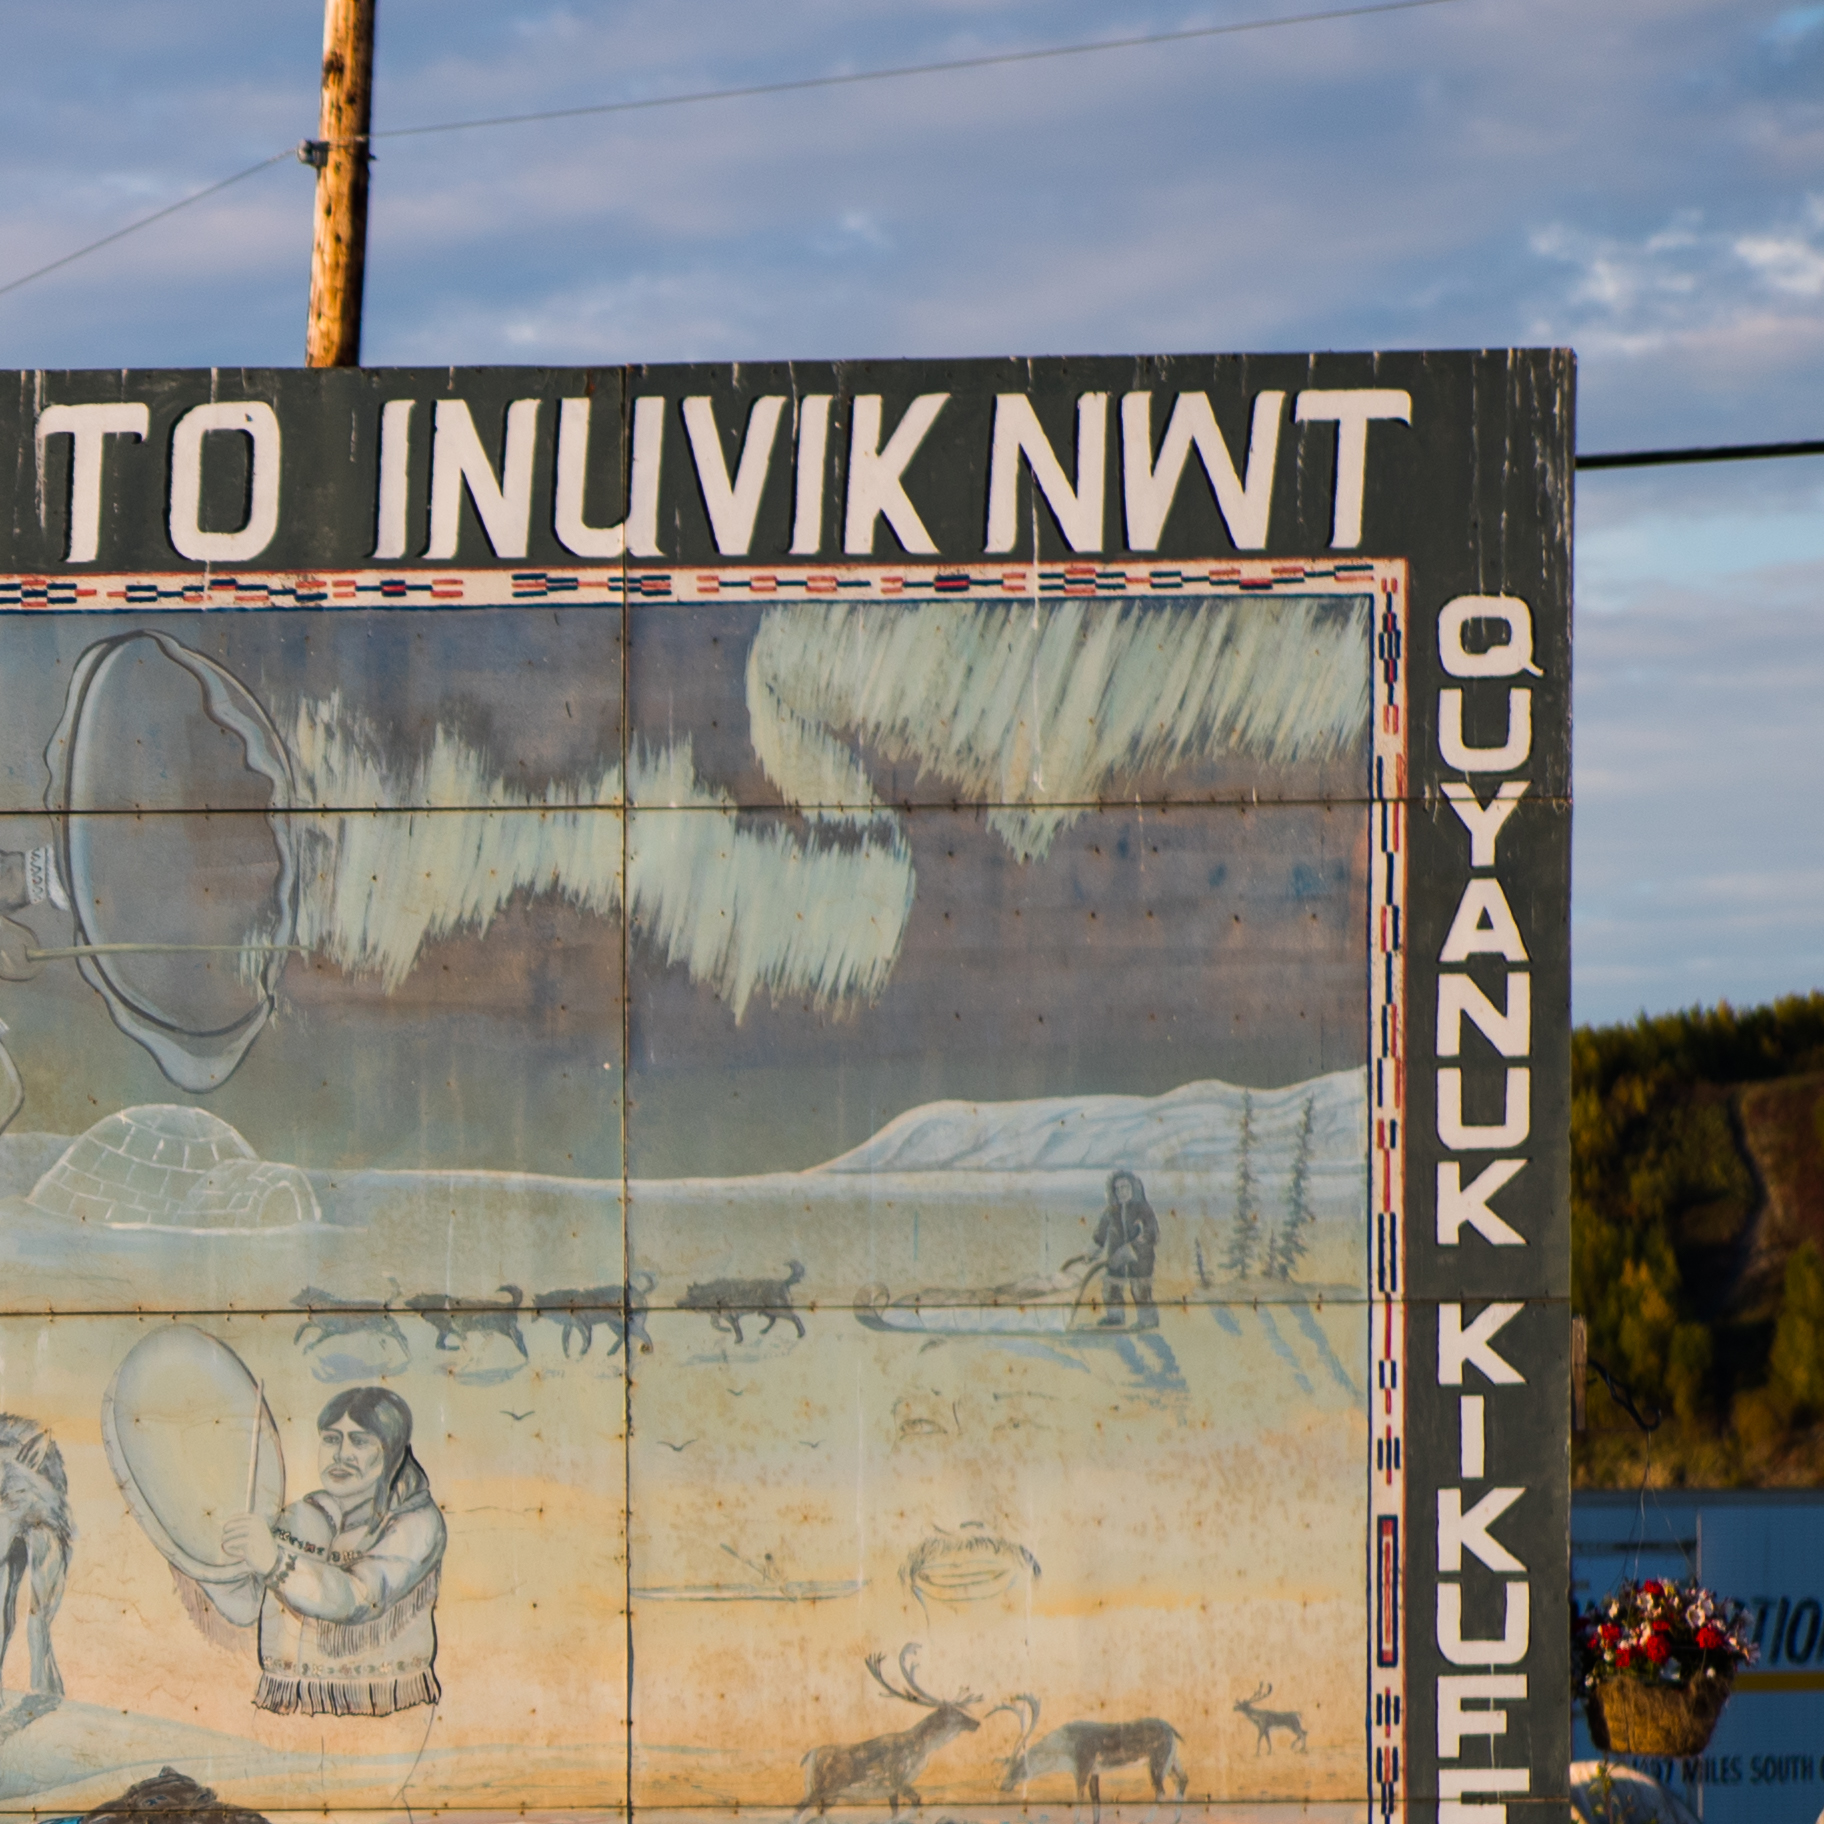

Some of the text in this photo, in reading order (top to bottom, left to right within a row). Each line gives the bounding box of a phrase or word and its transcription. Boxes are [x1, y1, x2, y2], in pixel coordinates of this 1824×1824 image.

[35, 402, 281, 563] TO
[374, 392, 949, 560] INUVIK
[984, 388, 1412, 554] NWT
[1436, 595, 1543, 1245] QUYANUK
[1682, 1756, 1743, 1786] MILES
[1749, 1755, 1815, 1785] SOUTH
